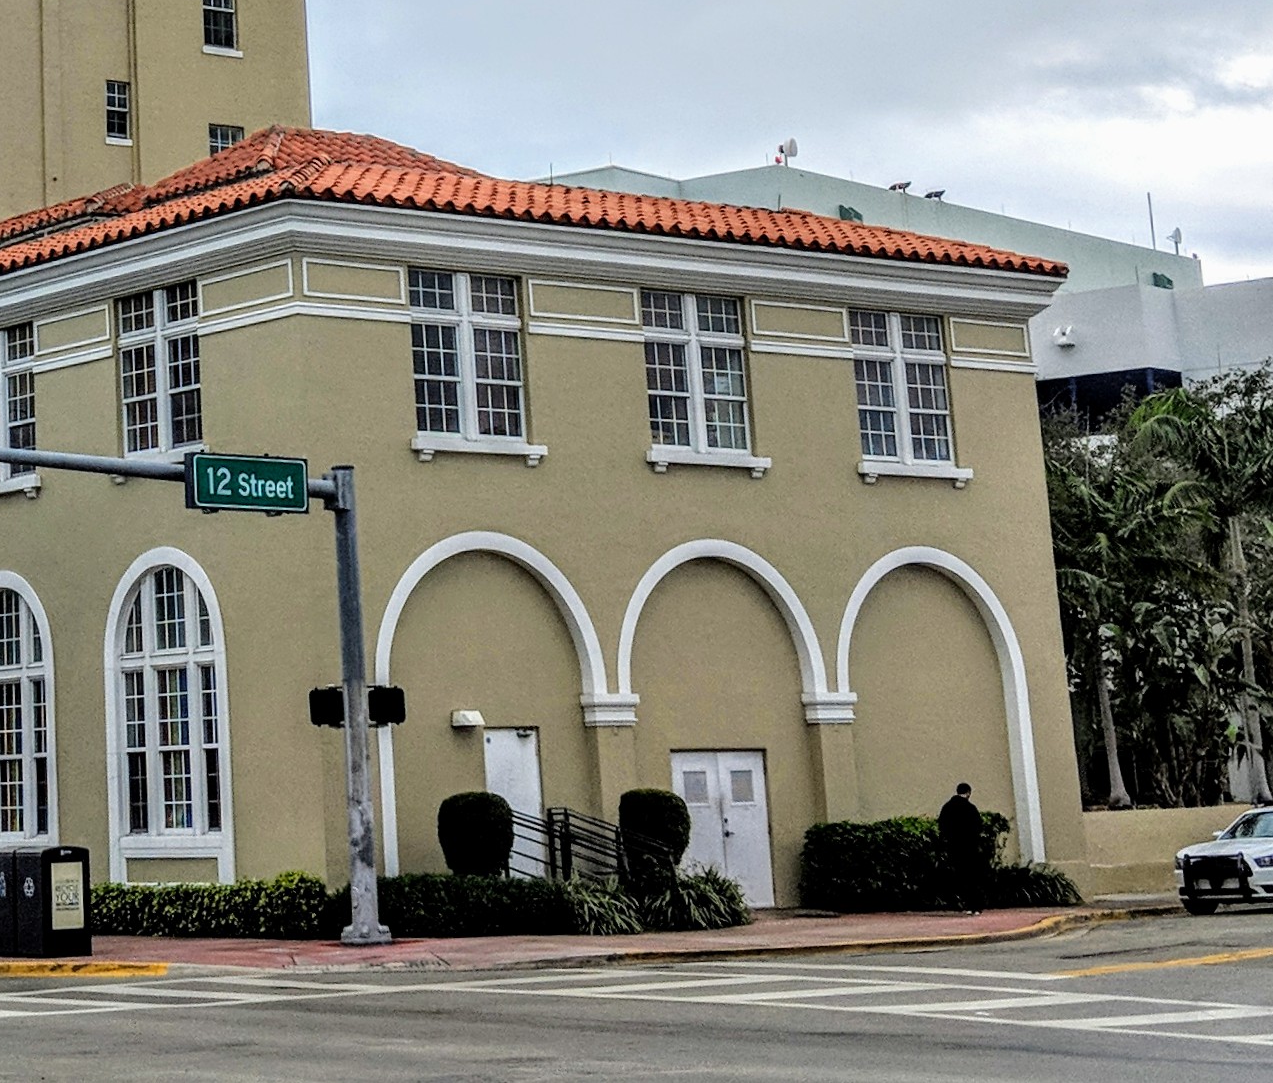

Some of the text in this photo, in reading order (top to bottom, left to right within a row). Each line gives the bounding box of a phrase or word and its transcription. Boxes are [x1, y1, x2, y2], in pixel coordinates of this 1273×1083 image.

[206, 466, 294, 499] 12 Street
[55, 892, 80, 902] YOUR
